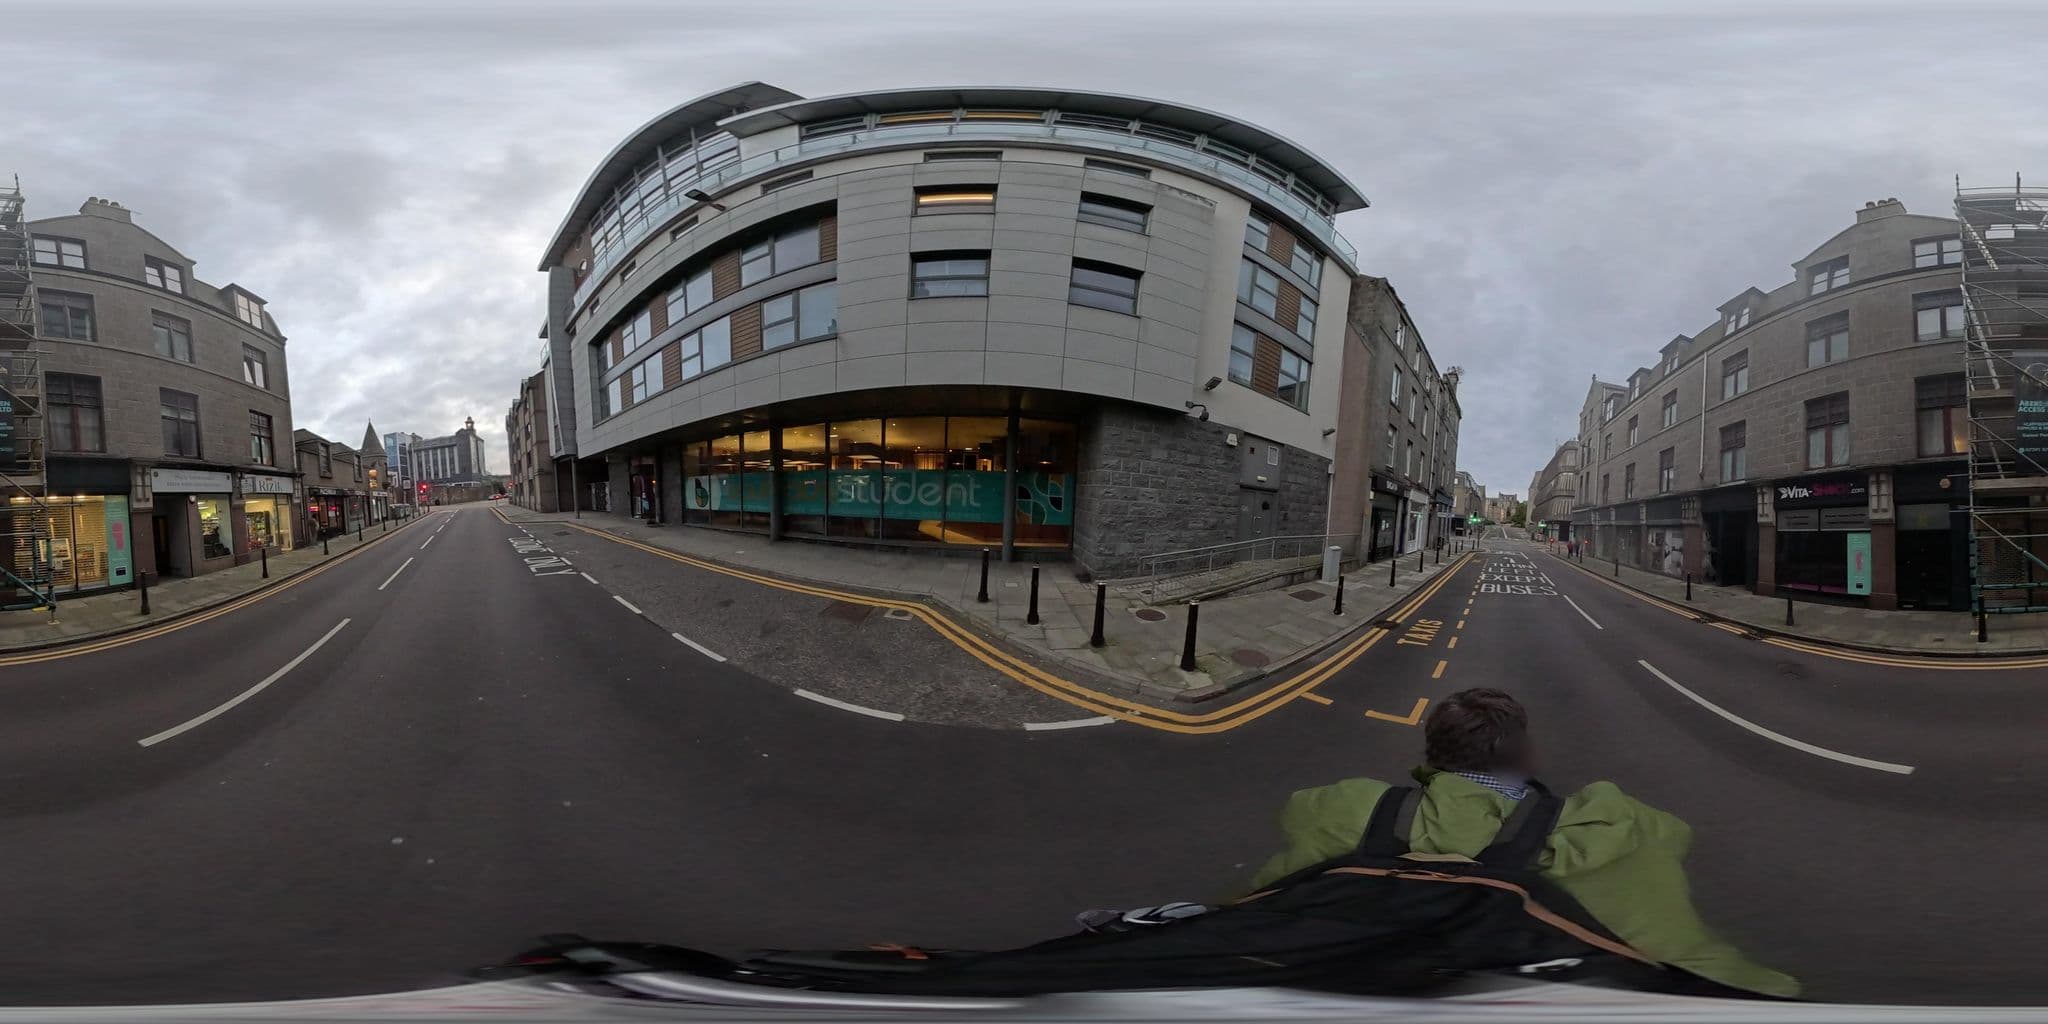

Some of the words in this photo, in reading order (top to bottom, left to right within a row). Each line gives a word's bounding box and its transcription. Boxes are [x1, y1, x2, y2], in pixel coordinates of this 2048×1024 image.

[523, 556, 577, 576] ONLY
[1488, 567, 1535, 575] LEFT
[1480, 573, 1546, 583] EXCEPT
[1480, 583, 1558, 596] BUSES
[1396, 619, 1443, 646] TAXIS
